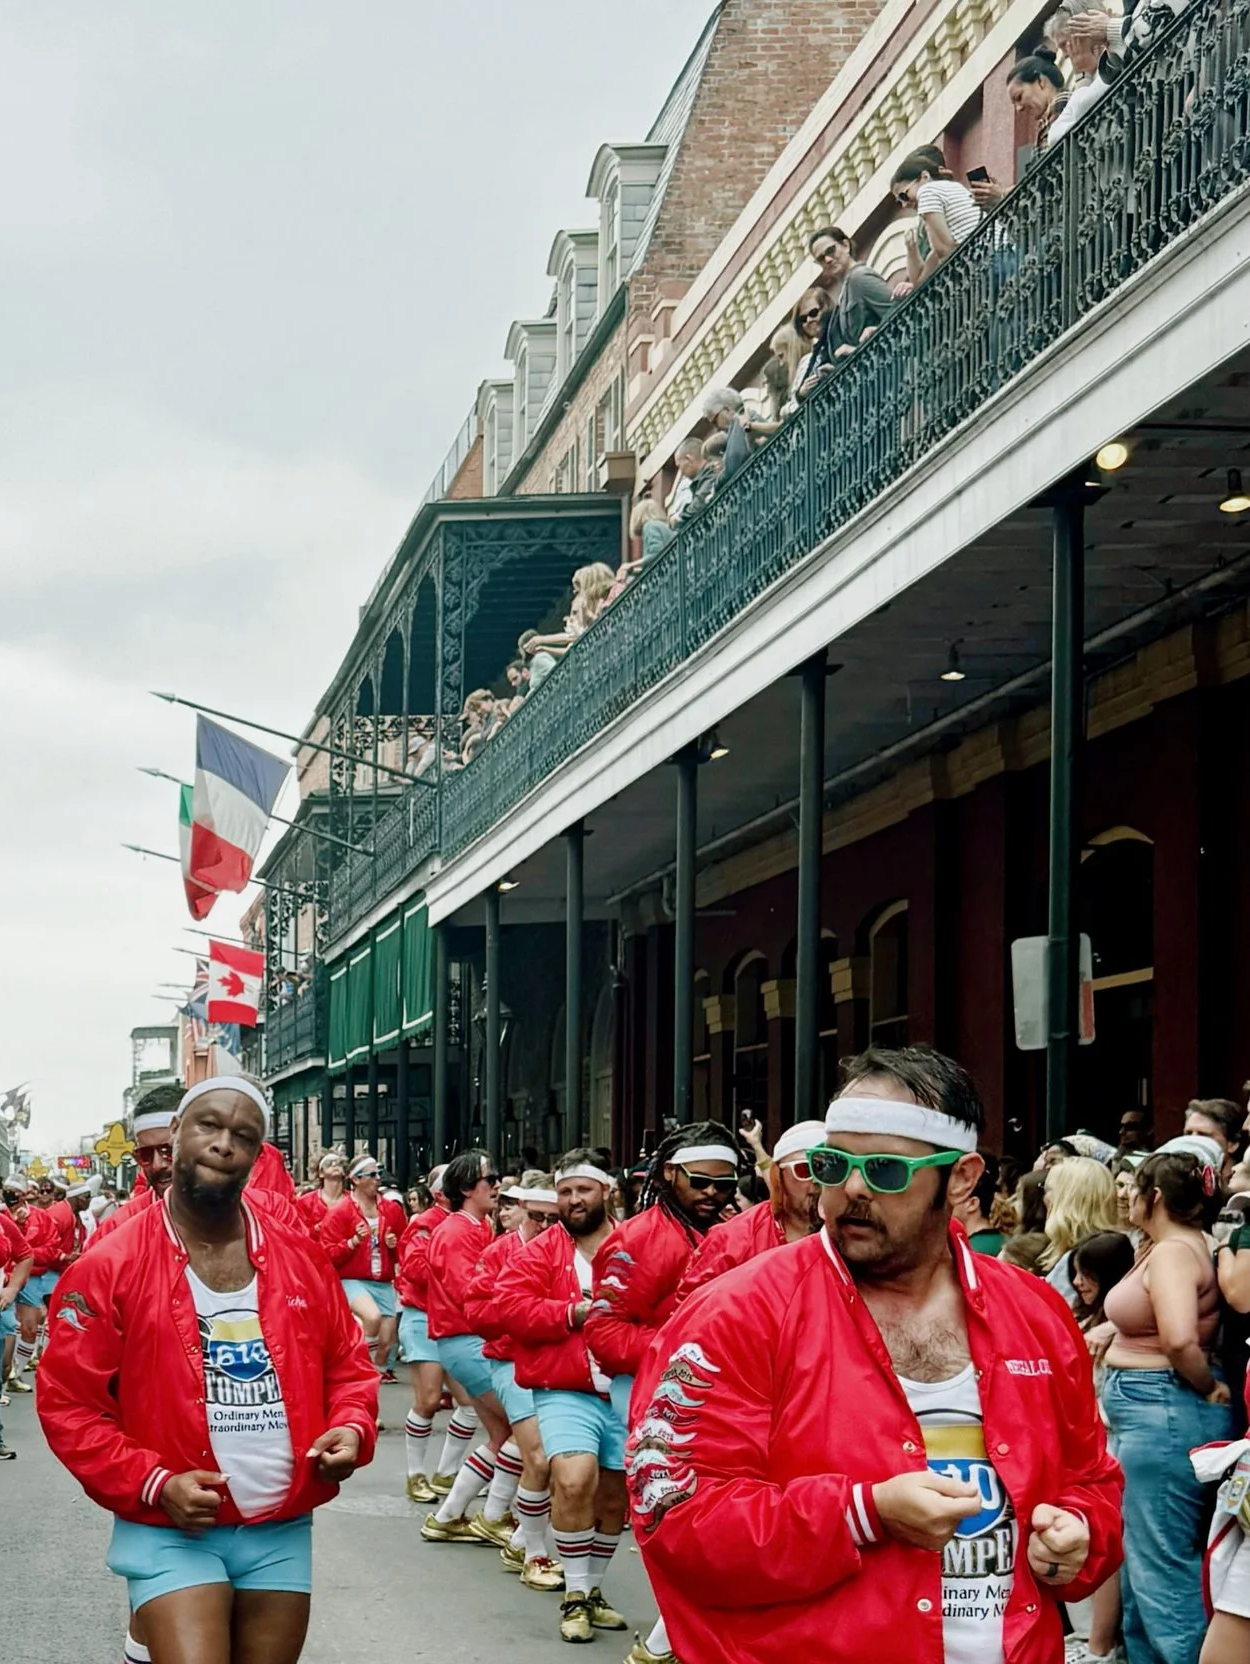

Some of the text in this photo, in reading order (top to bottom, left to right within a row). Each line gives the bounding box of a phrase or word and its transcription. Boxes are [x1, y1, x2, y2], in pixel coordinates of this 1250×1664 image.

[216, 1342, 268, 1367] 610
[205, 1369, 282, 1404] TOMPE
[213, 1410, 260, 1422] Ordinary
[210, 1420, 288, 1433] traordinary Mov
[944, 1586, 980, 1601] inary
